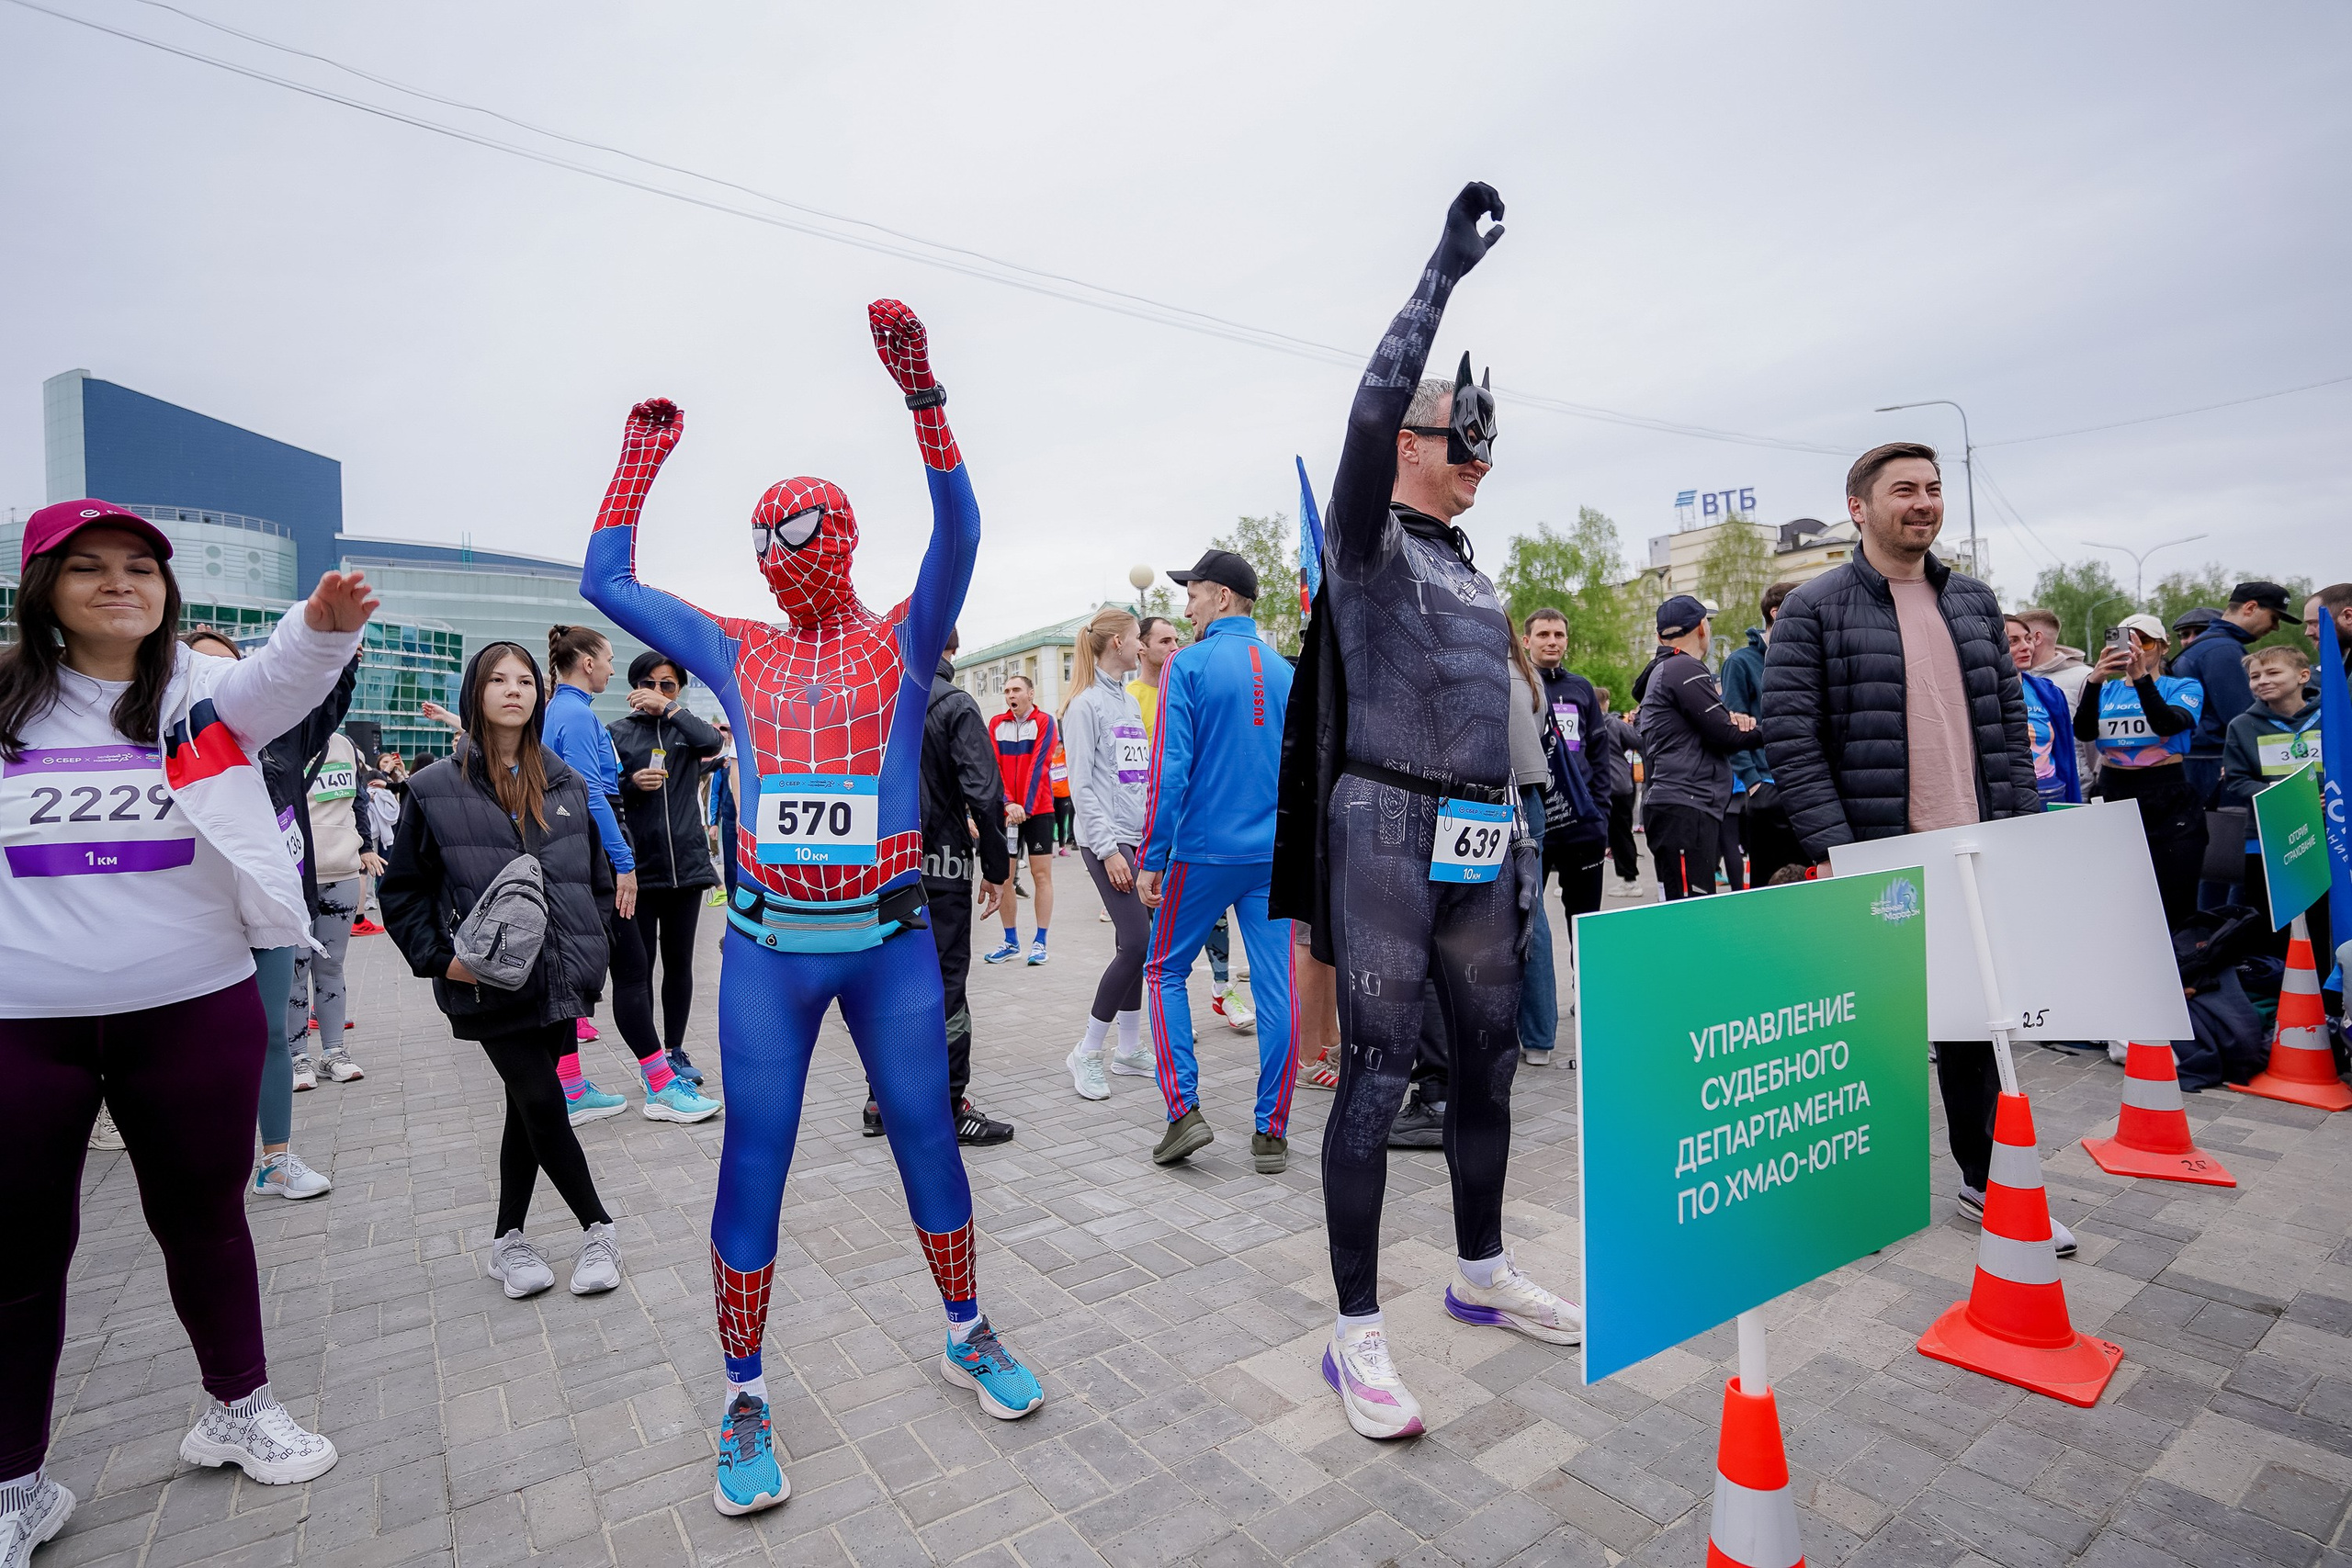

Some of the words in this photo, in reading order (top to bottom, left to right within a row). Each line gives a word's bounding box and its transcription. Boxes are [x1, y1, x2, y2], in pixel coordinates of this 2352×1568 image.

[1702, 487, 1757, 516] ВТБ
[1253, 674, 1264, 727] RUSSIA
[2108, 719, 2145, 736] 710
[315, 773, 353, 789] 1407
[29, 784, 175, 825] 2229
[778, 801, 852, 836] 570
[1454, 827, 1501, 858] 639
[2283, 834, 2316, 865] СТРАХОВАНИЕ
[2288, 823, 2309, 845] ЮГОРИЯ
[1689, 991, 1857, 1063] УПРАВЛЕНИЕ
[2022, 1009, 2050, 1028] 25
[1701, 1040, 1849, 1111] СУДЕБНОГО
[1674, 1080, 1871, 1179] ДЕПАРТАМЕНТА
[1678, 1180, 1720, 1225] ПО
[1724, 1124, 1871, 1207] ХМАО-ЮГРЕ
